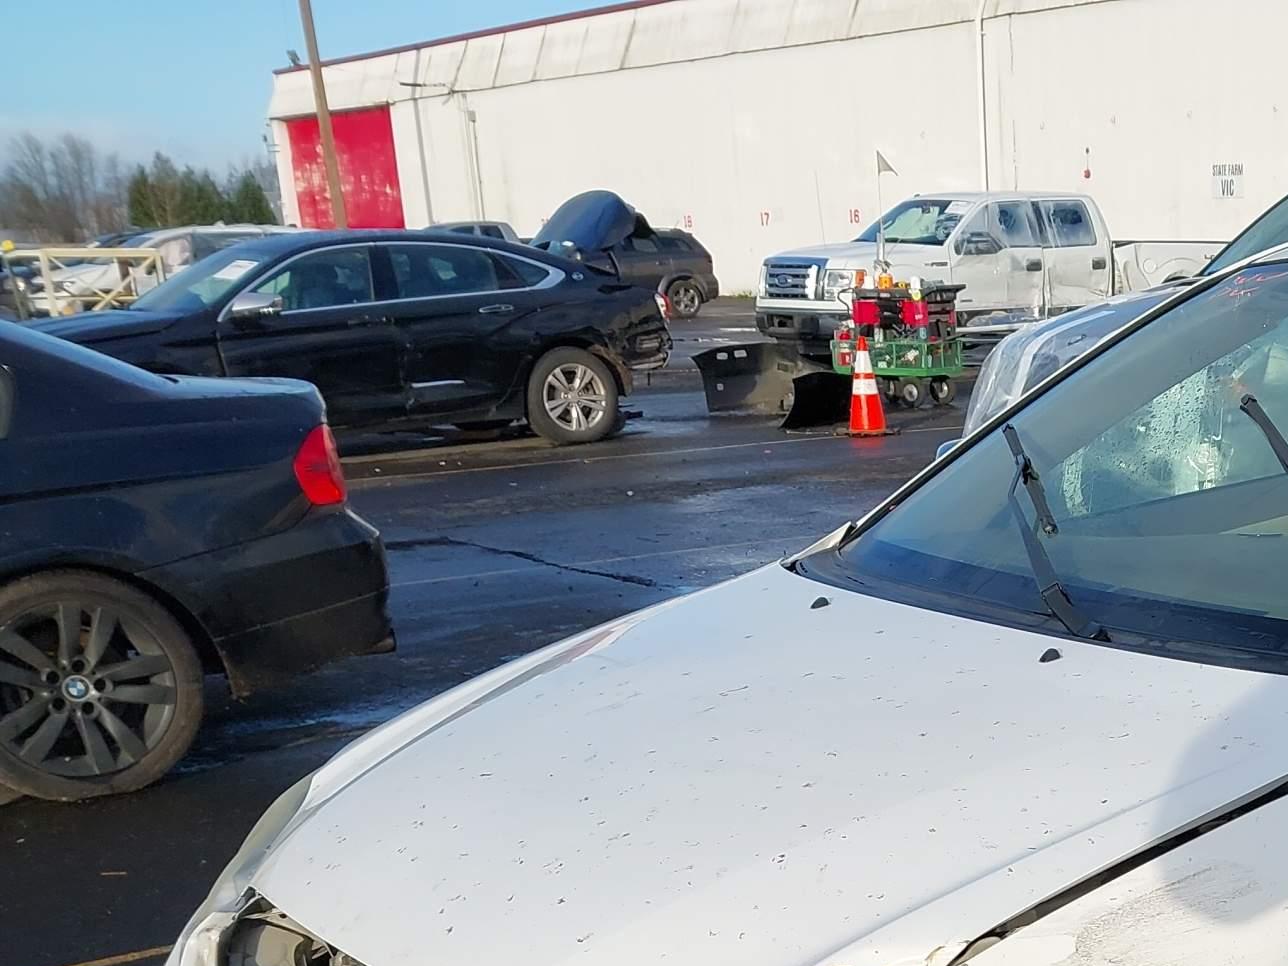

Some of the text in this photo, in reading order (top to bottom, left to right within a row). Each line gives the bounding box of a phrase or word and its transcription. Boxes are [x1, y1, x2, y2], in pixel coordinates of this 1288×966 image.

[1212, 163, 1244, 177] STATE FARM
[1221, 179, 1235, 197] VIC
[760, 212, 770, 227] 17
[849, 208, 860, 224] 16
